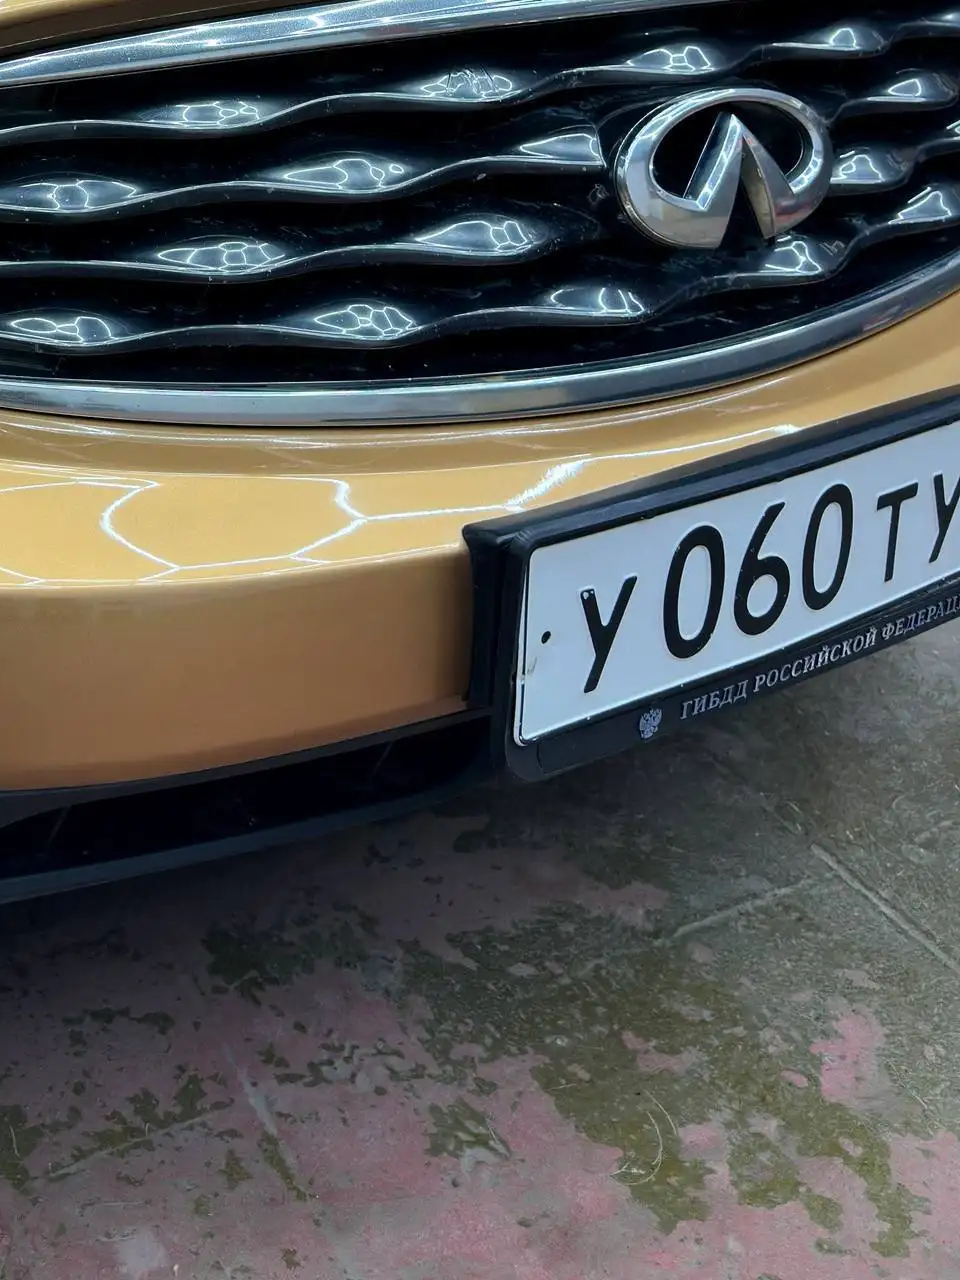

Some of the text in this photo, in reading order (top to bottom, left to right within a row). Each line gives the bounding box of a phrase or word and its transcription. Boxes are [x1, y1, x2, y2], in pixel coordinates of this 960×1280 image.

[680, 593, 960, 720] ГИБДД РОССИЙСКОЙ ФЕДЕРАЦ
